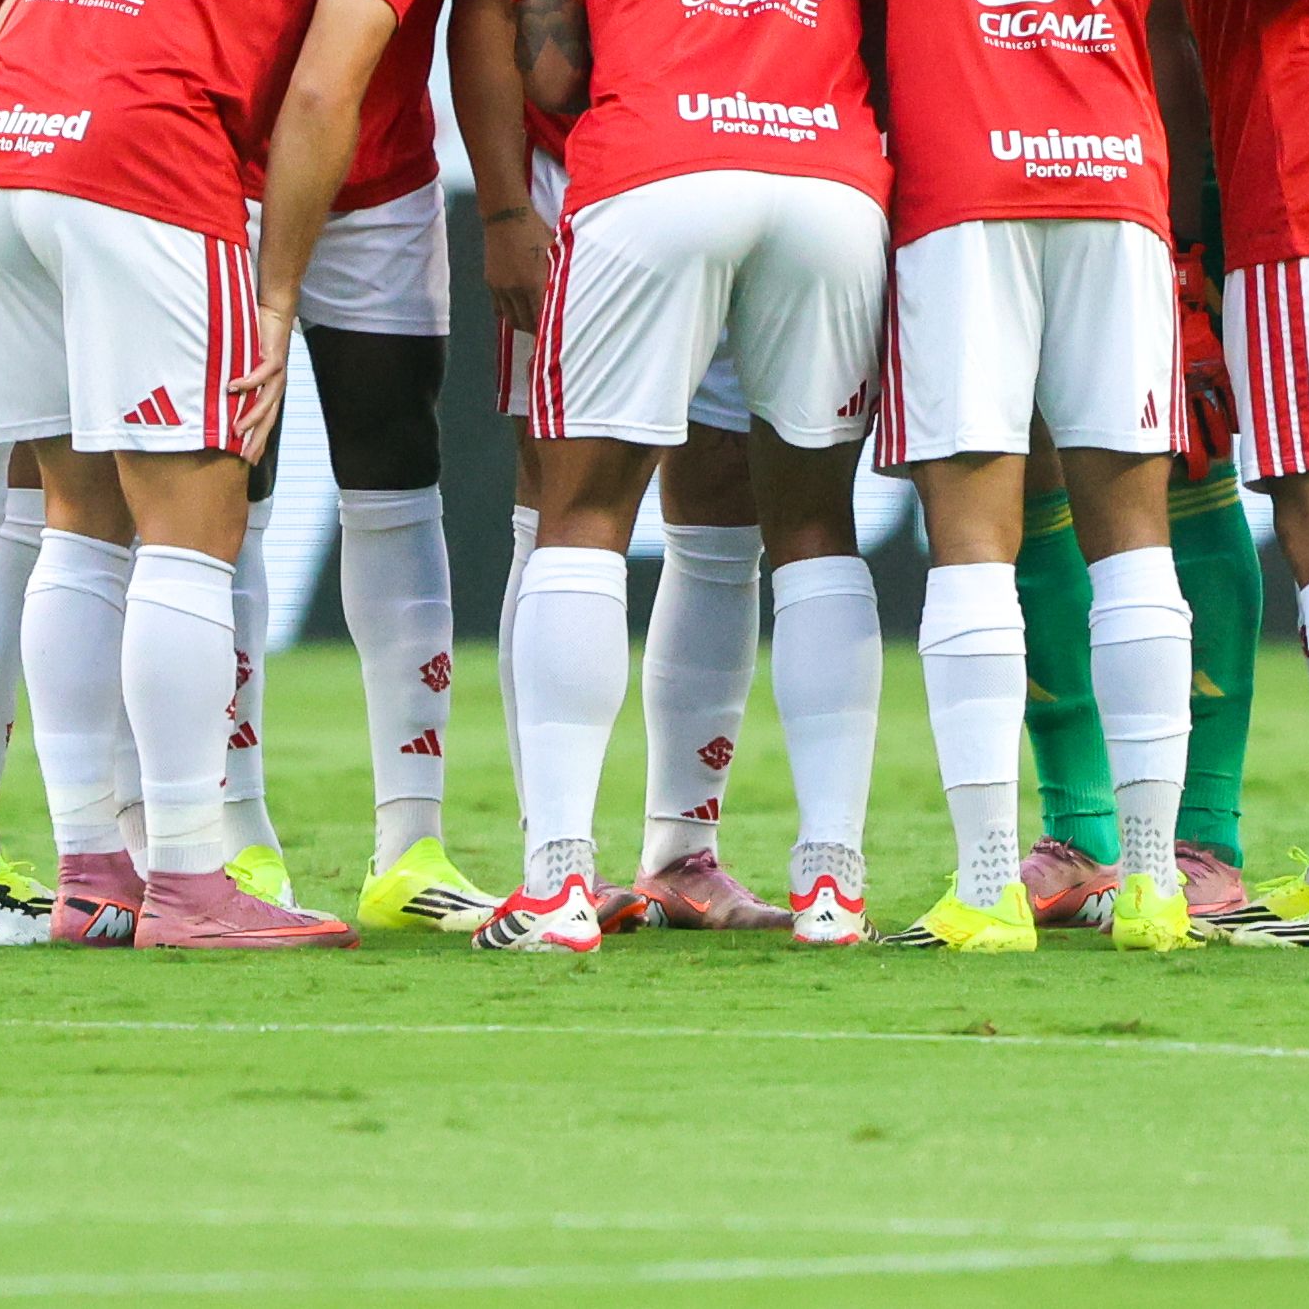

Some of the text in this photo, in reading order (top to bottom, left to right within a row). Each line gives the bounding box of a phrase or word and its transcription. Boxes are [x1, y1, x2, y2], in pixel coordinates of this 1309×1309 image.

[980, 10, 1114, 39] CIGAME
[677, 91, 839, 130] Unimed
[712, 119, 817, 143] Porto Alegre
[14, 136, 55, 157] Alegre
[990, 128, 1143, 166] Unimed
[1025, 161, 1128, 182] Porto Alegre
